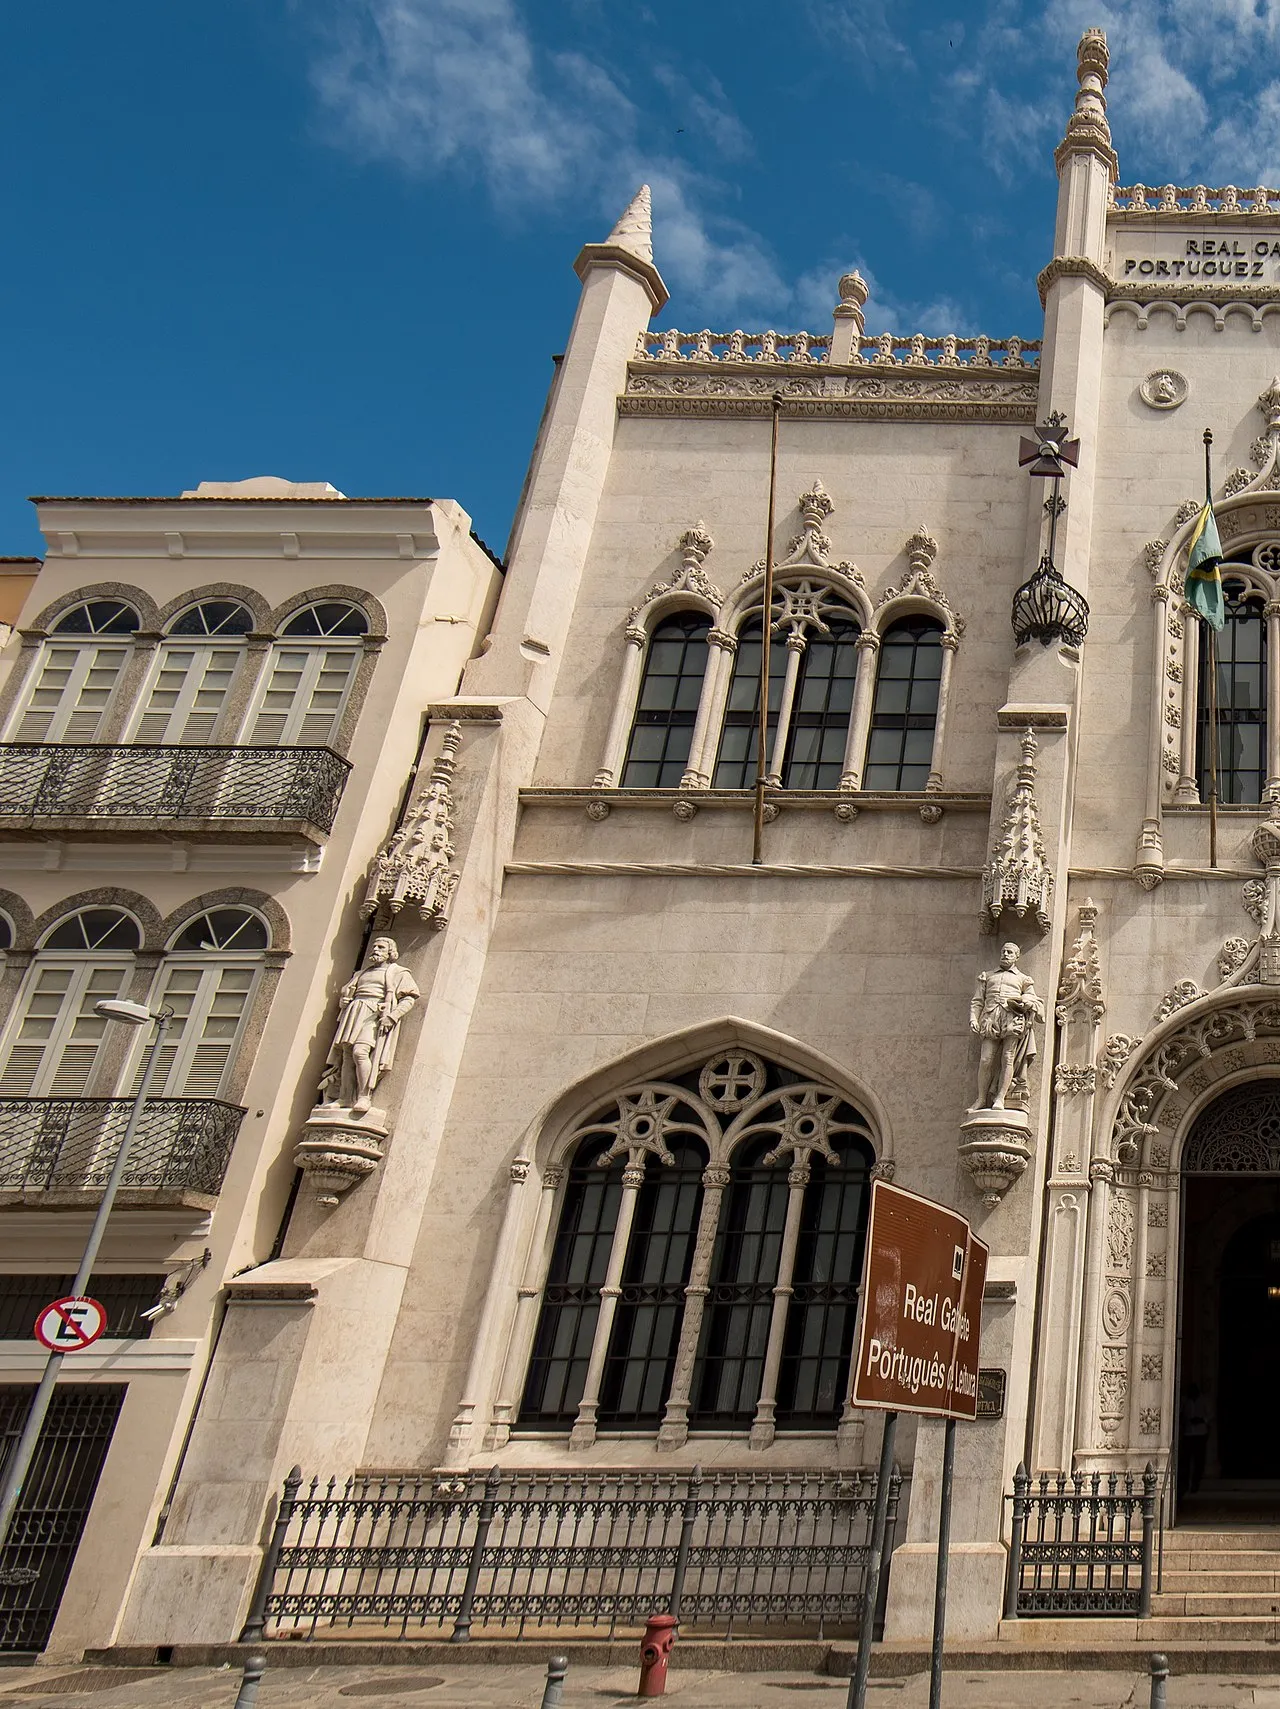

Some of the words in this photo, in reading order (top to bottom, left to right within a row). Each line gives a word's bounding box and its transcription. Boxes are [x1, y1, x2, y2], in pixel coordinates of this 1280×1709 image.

[1186, 239, 1246, 257] REAL
[1124, 258, 1264, 277] PORTUGUEZ
[904, 1283, 939, 1327] Real
[55, 1307, 89, 1340] E
[866, 1338, 946, 1394] Português
